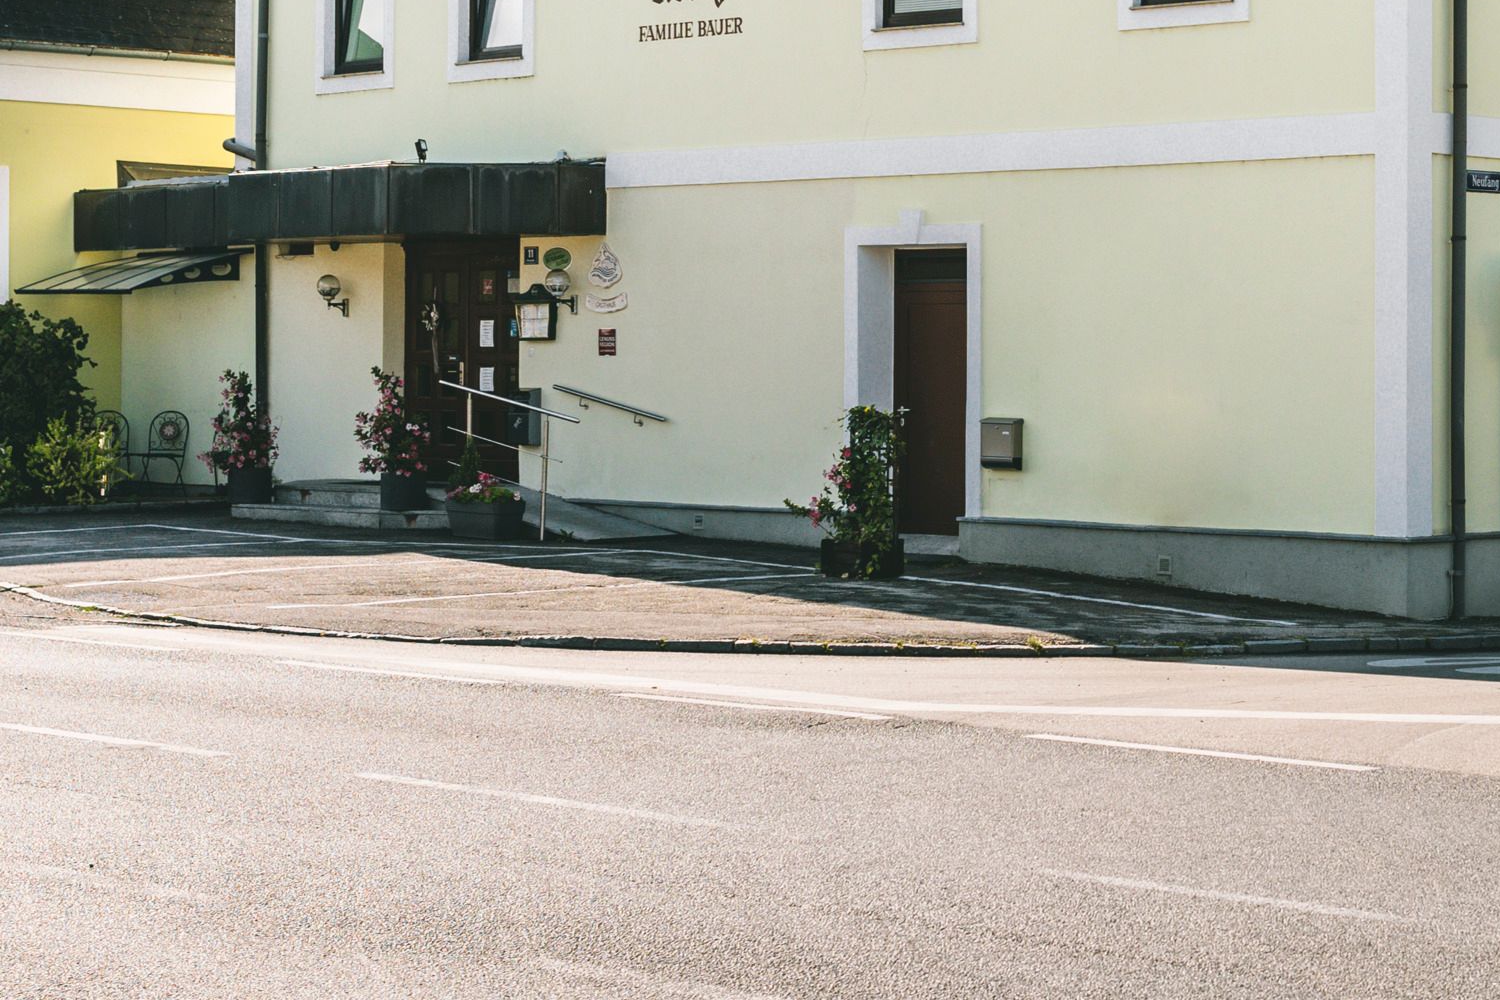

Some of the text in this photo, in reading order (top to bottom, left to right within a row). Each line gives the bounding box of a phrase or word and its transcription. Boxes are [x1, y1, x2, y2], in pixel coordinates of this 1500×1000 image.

[638, 17, 743, 42] FAMILIE BAUER
[1471, 174, 1500, 191] Neufang
